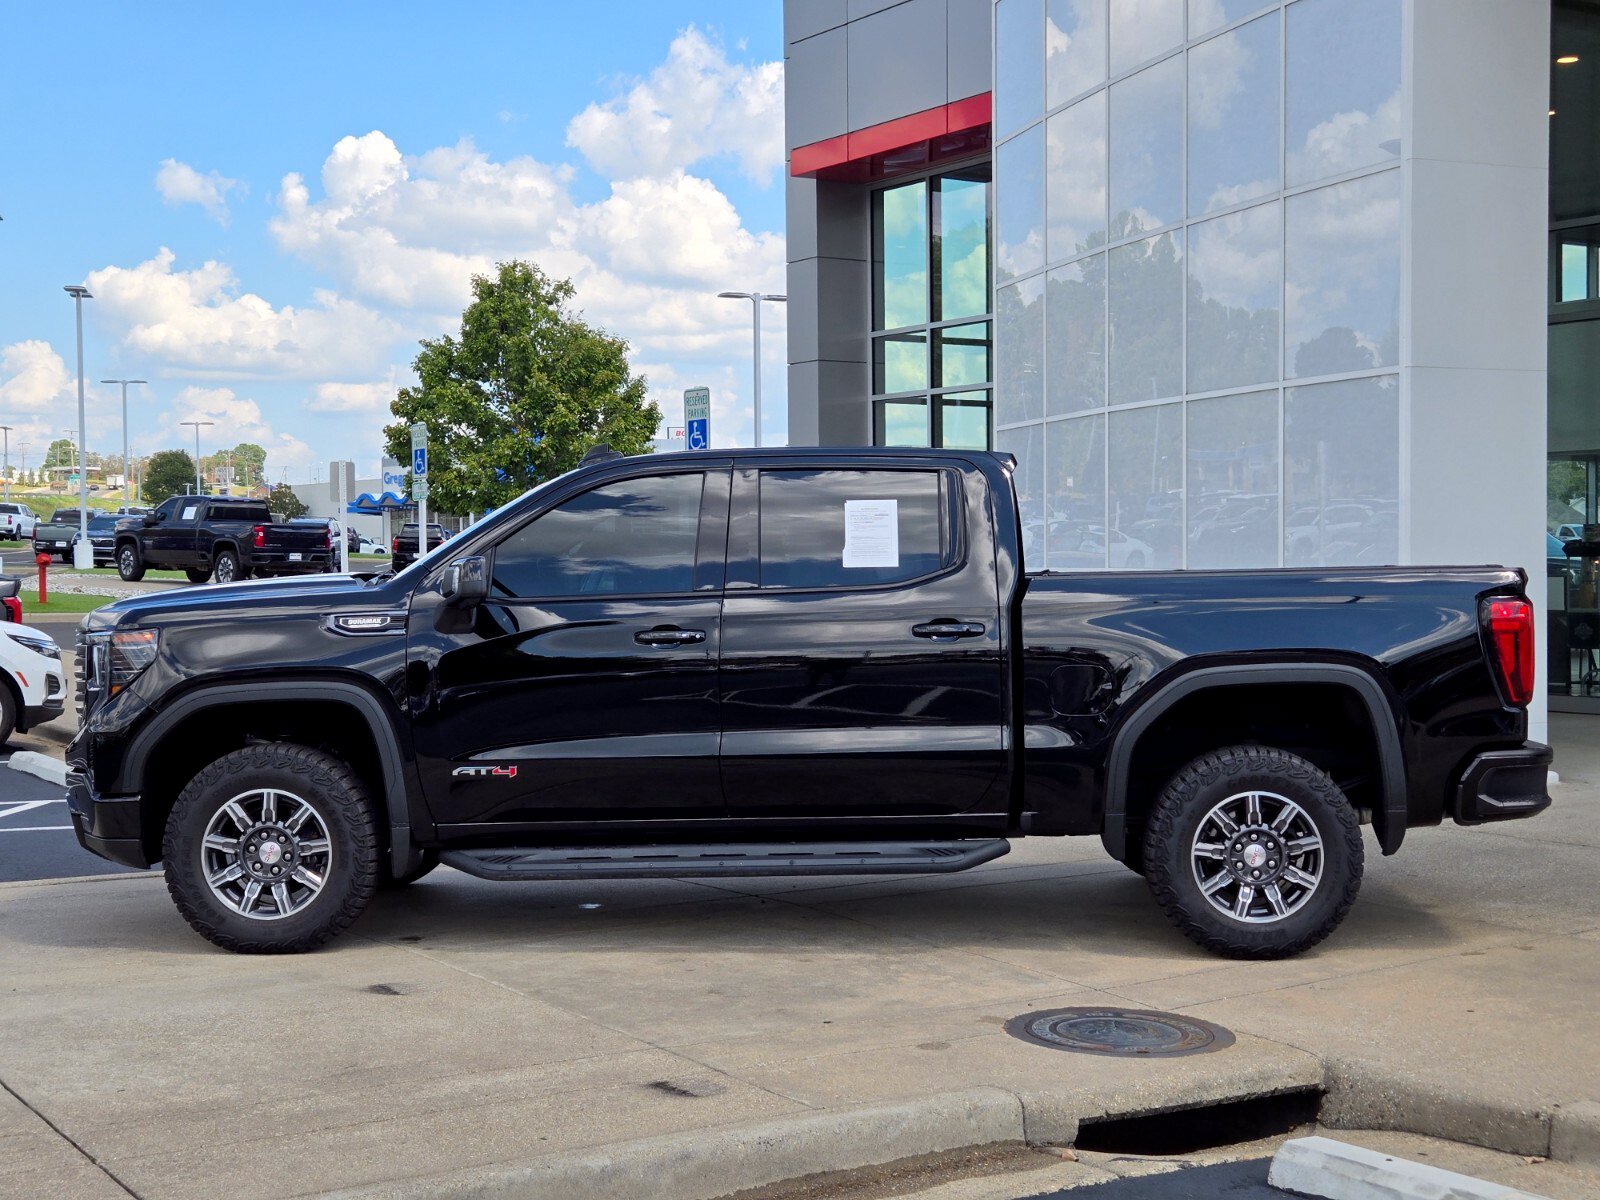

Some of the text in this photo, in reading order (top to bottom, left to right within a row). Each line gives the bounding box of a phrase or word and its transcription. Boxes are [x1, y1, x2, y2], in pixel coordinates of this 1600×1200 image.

[686, 395, 708, 407] RESERVED
[688, 407, 707, 418] PARKING
[452, 766, 518, 778] AT4
